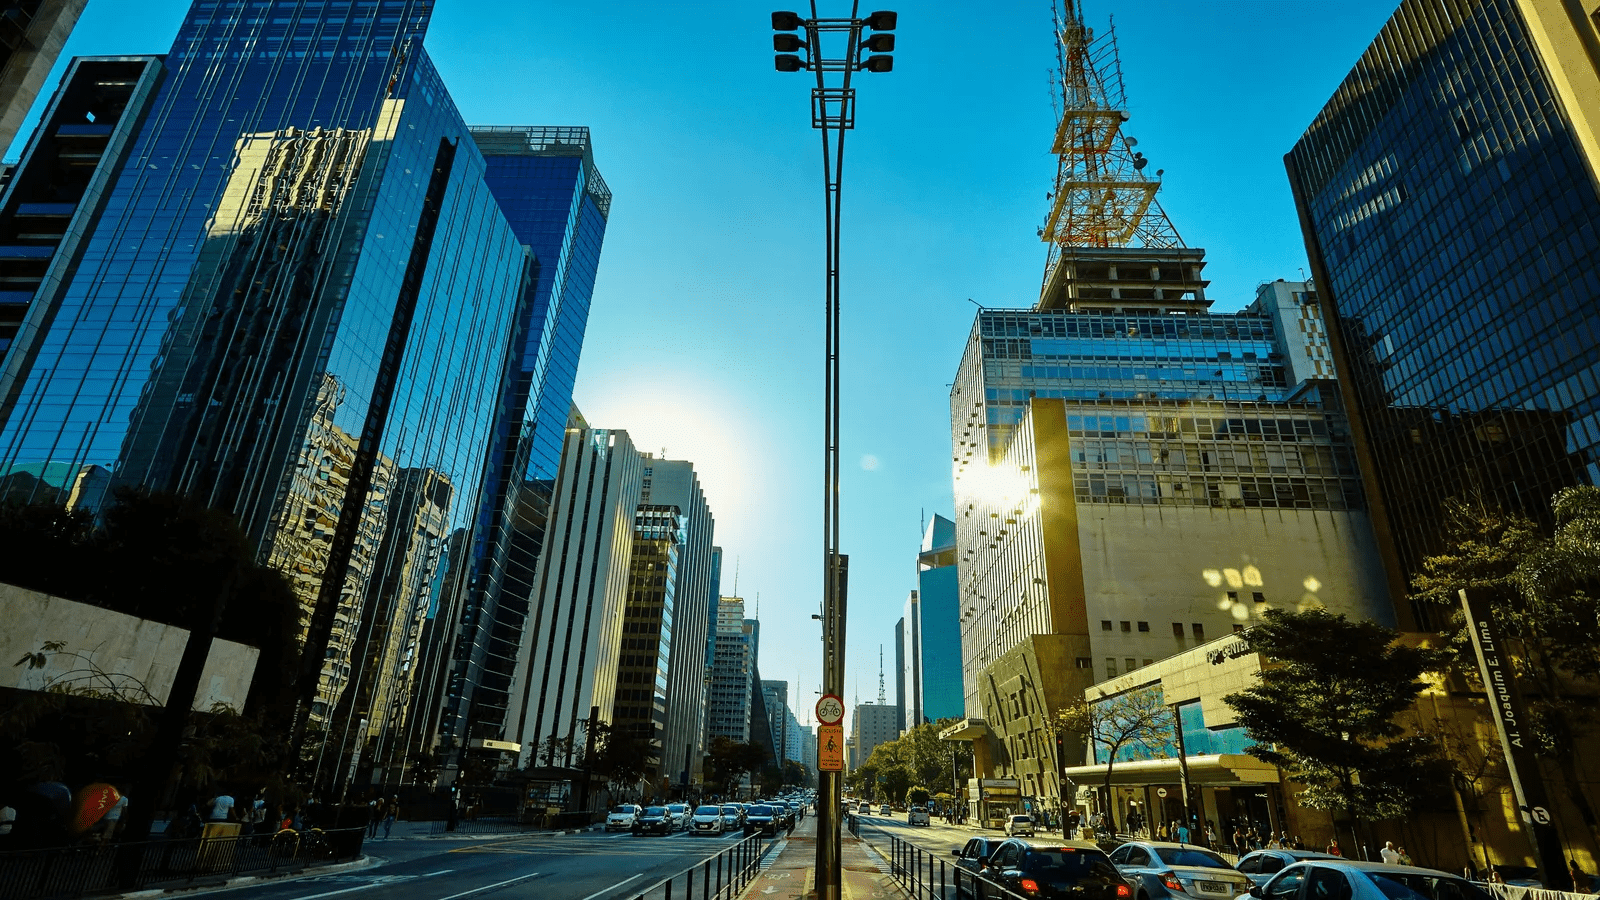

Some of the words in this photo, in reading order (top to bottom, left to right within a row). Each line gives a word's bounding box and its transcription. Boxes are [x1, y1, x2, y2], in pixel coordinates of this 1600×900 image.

[1479, 621, 1495, 652] Lima
[1487, 655, 1500, 667] E.
[1493, 670, 1516, 727] Joaquim
[1509, 731, 1524, 748] Al.
[97, 788, 109, 810] vivo
